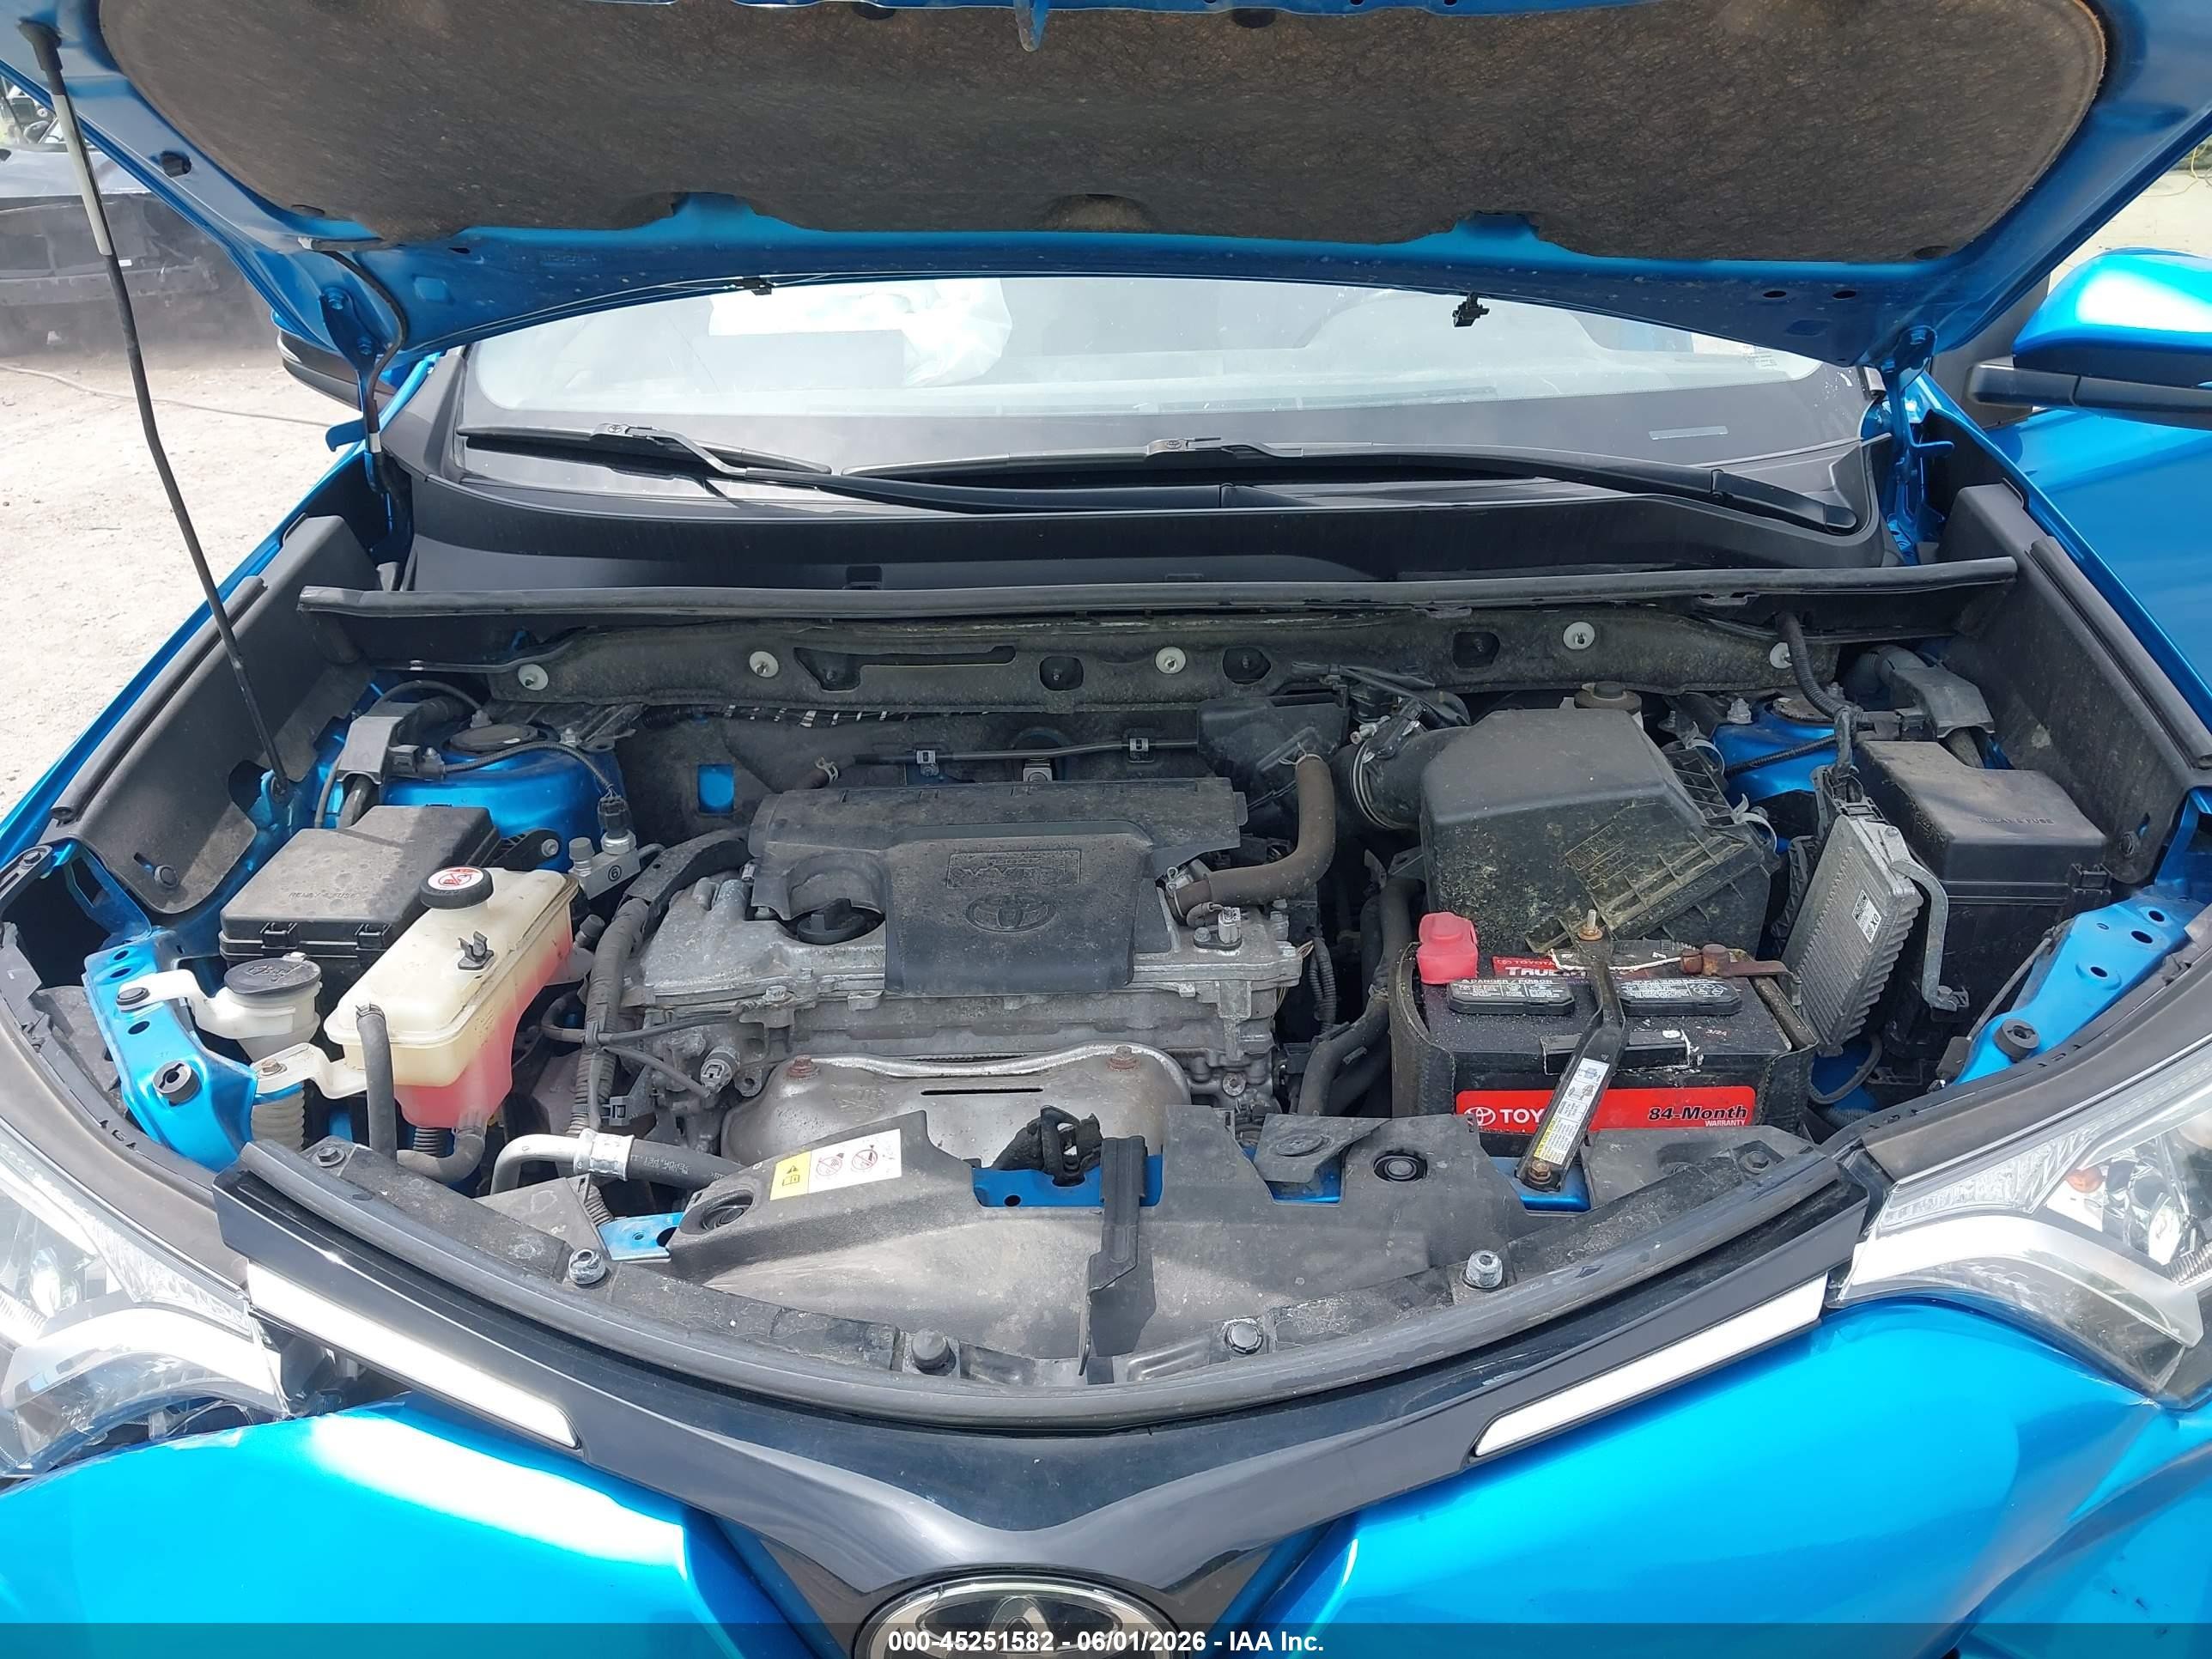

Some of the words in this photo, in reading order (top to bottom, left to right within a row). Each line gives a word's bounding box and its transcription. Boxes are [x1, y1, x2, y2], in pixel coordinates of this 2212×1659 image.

[1499, 1108, 1545, 1124] TOY
[1648, 1104, 1748, 1121] 84-Month
[1705, 1119, 1746, 1127] WARRANTY
